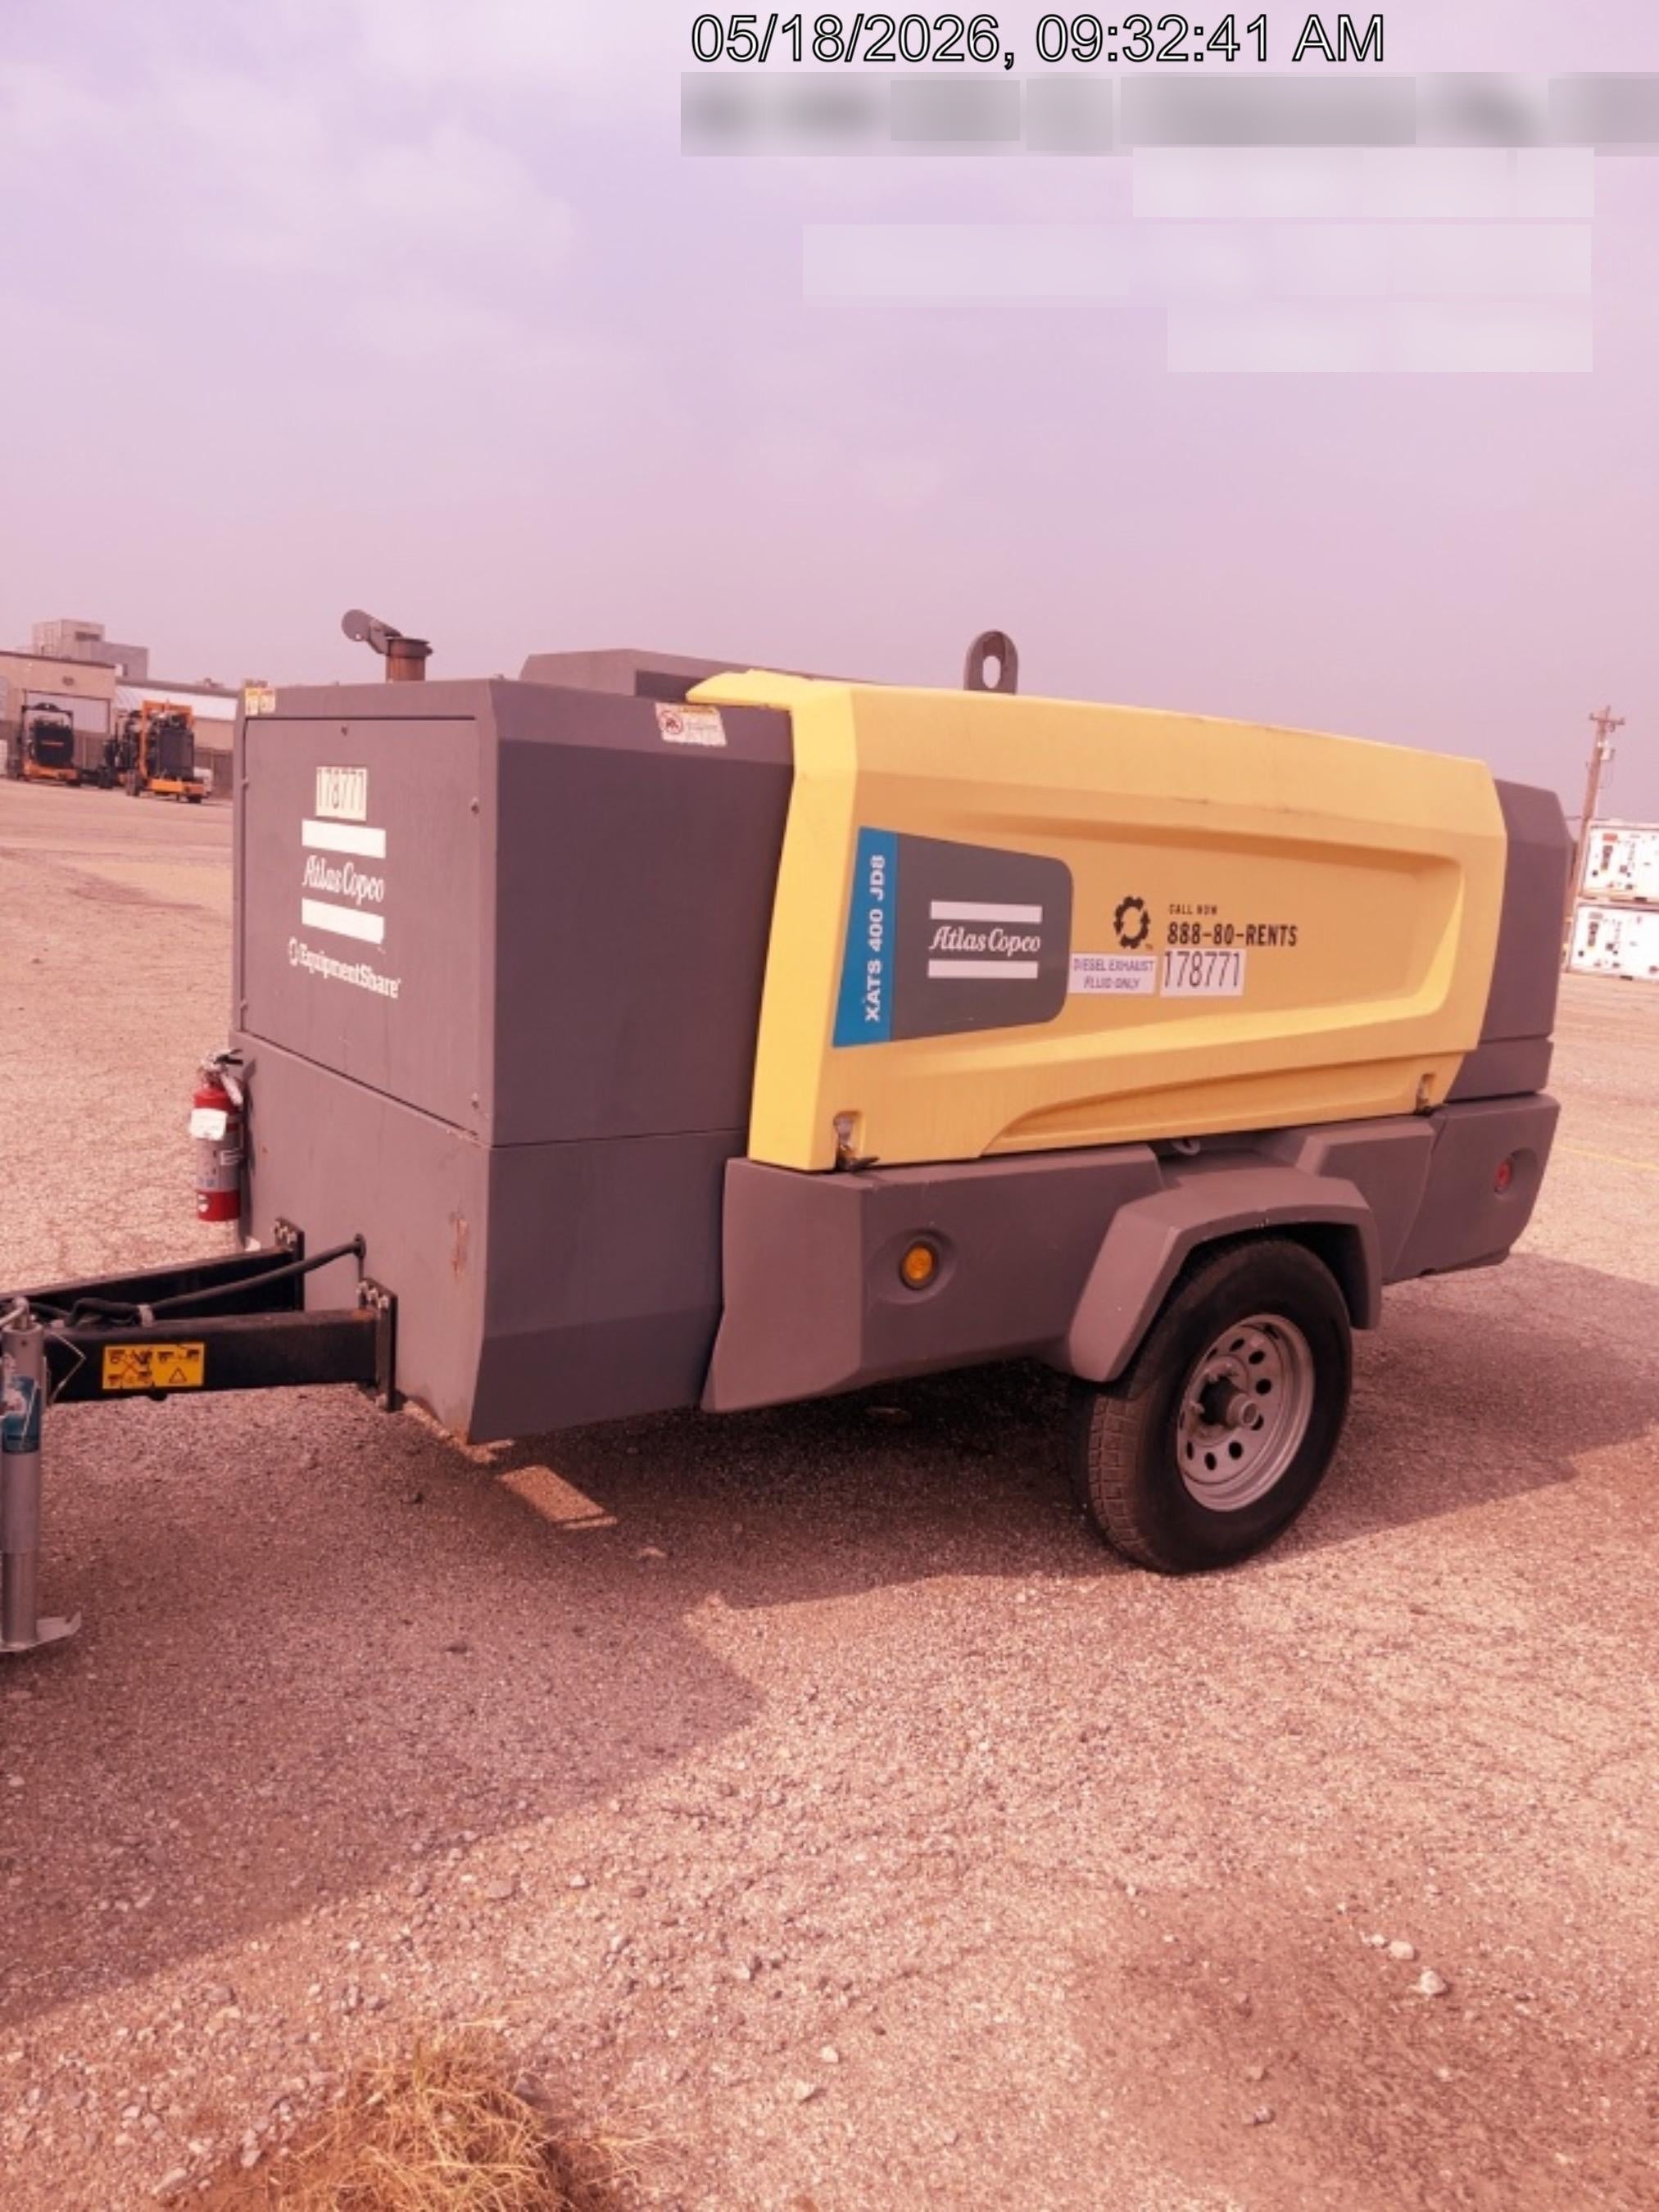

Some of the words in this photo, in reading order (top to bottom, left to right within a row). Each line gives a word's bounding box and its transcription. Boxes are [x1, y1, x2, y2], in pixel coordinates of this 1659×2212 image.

[301, 854, 342, 894] Atlas
[342, 861, 384, 906] Copco
[869, 854, 886, 902] JD8
[1169, 904, 1193, 915] CALL
[1197, 904, 1218, 916] NOW
[868, 909, 884, 953] 400
[928, 926, 987, 952] Atlas
[988, 927, 1041, 958] Copco
[1167, 921, 1299, 947] 888-80-RENTS
[298, 942, 399, 999] EquipmentShare
[1074, 958, 1107, 972] DIESEL
[1108, 959, 1154, 972] EXHAUST
[1163, 950, 1240, 988] 178771
[865, 959, 882, 1022] XATS
